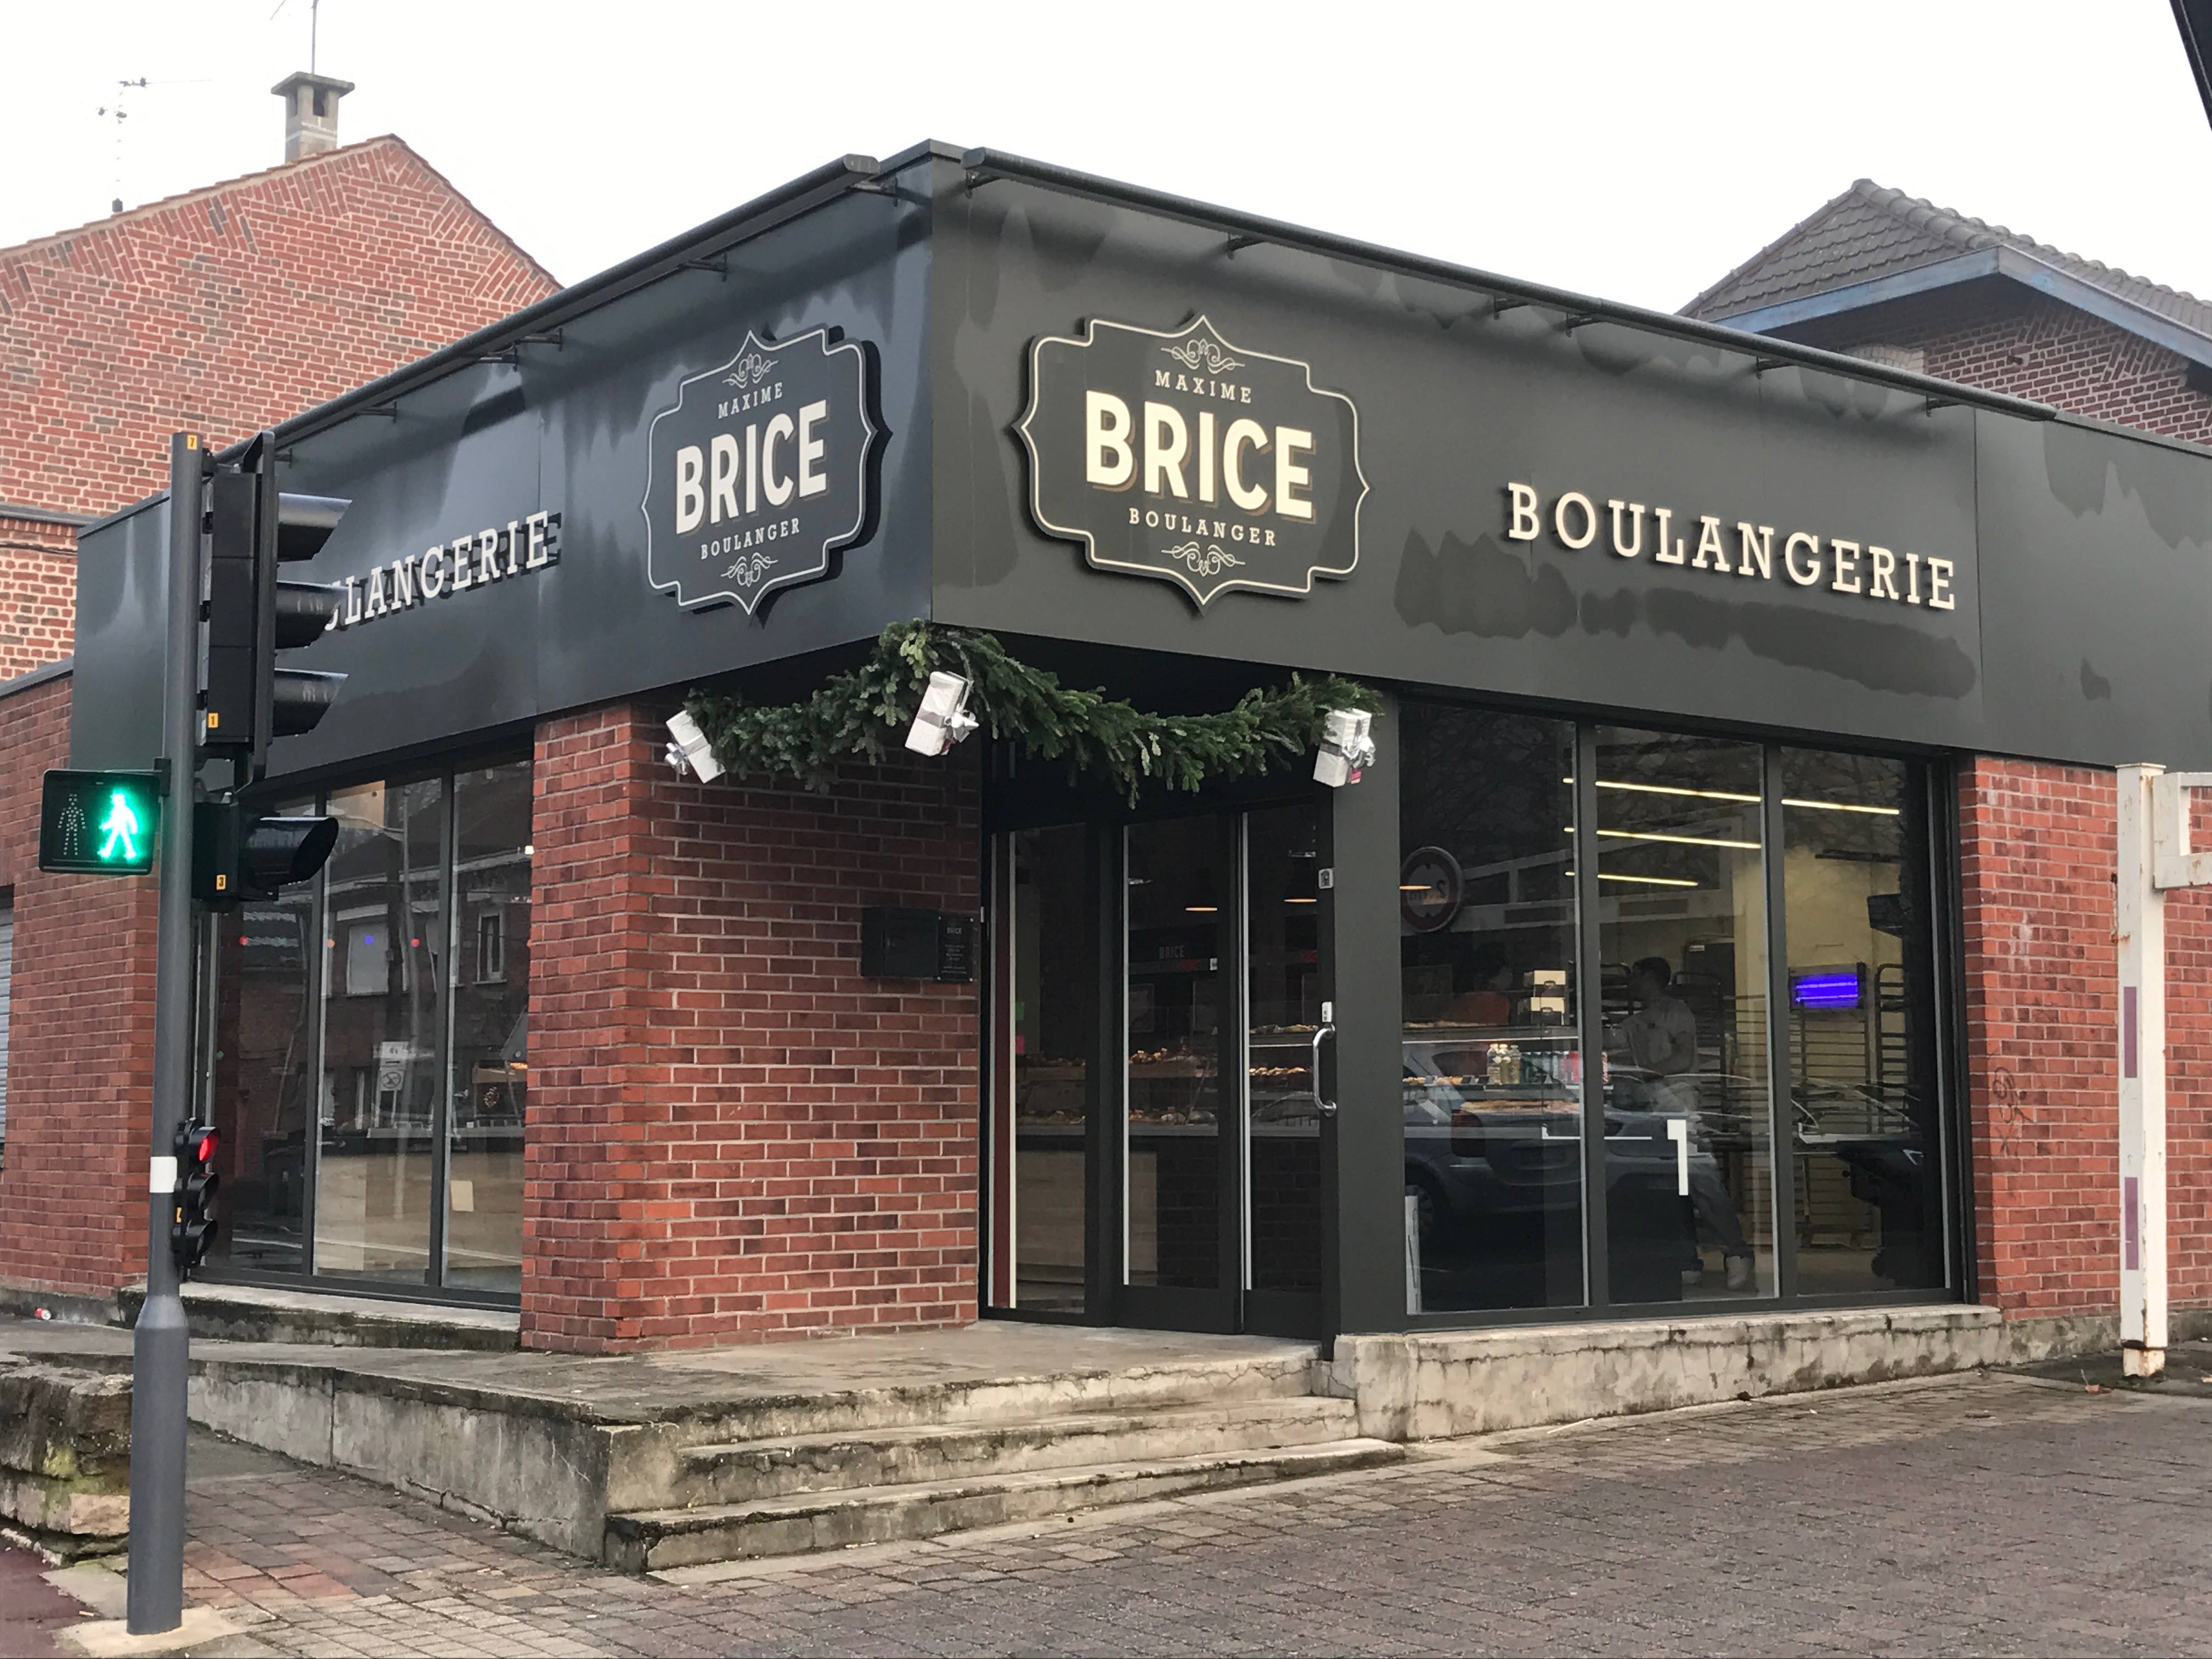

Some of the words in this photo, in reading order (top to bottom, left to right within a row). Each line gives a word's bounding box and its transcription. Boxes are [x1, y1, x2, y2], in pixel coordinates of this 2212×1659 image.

[717, 381, 783, 419] MAXIME
[1154, 370, 1252, 404] MAXIME
[676, 399, 828, 535] BRICE
[1086, 390, 1314, 521] BRICE
[701, 517, 800, 560] BOULANGER
[1128, 507, 1277, 547] BOULANGER
[1507, 481, 1955, 610] BOULANGERIE
[324, 510, 548, 631] LANGERIE
